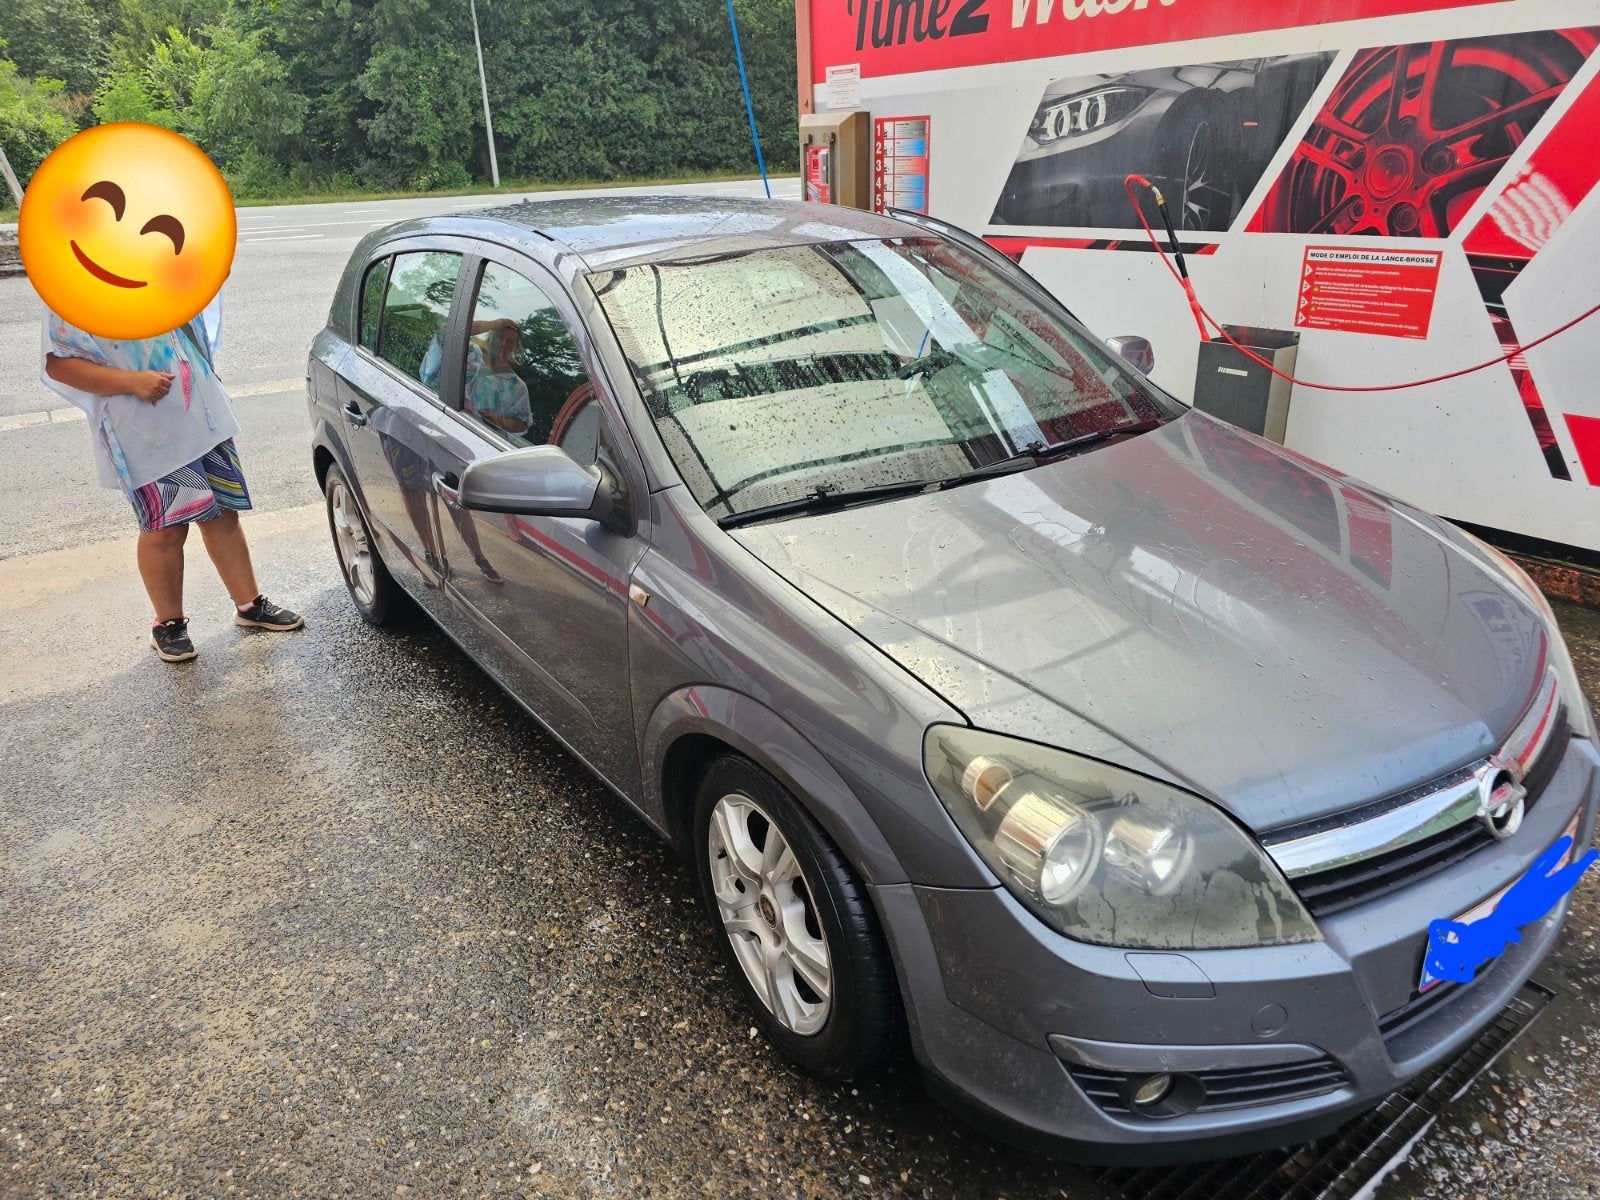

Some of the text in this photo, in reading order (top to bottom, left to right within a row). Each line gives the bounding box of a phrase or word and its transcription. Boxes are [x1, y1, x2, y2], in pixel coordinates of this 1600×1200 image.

[876, 123, 881, 137] 1
[876, 141, 882, 155] 2
[876, 159, 882, 172] 3
[876, 176, 882, 189] 4
[876, 193, 882, 206] 5
[1330, 252, 1360, 260] D'EMPLOI
[1381, 255, 1434, 264] LANCE-BROSSE
